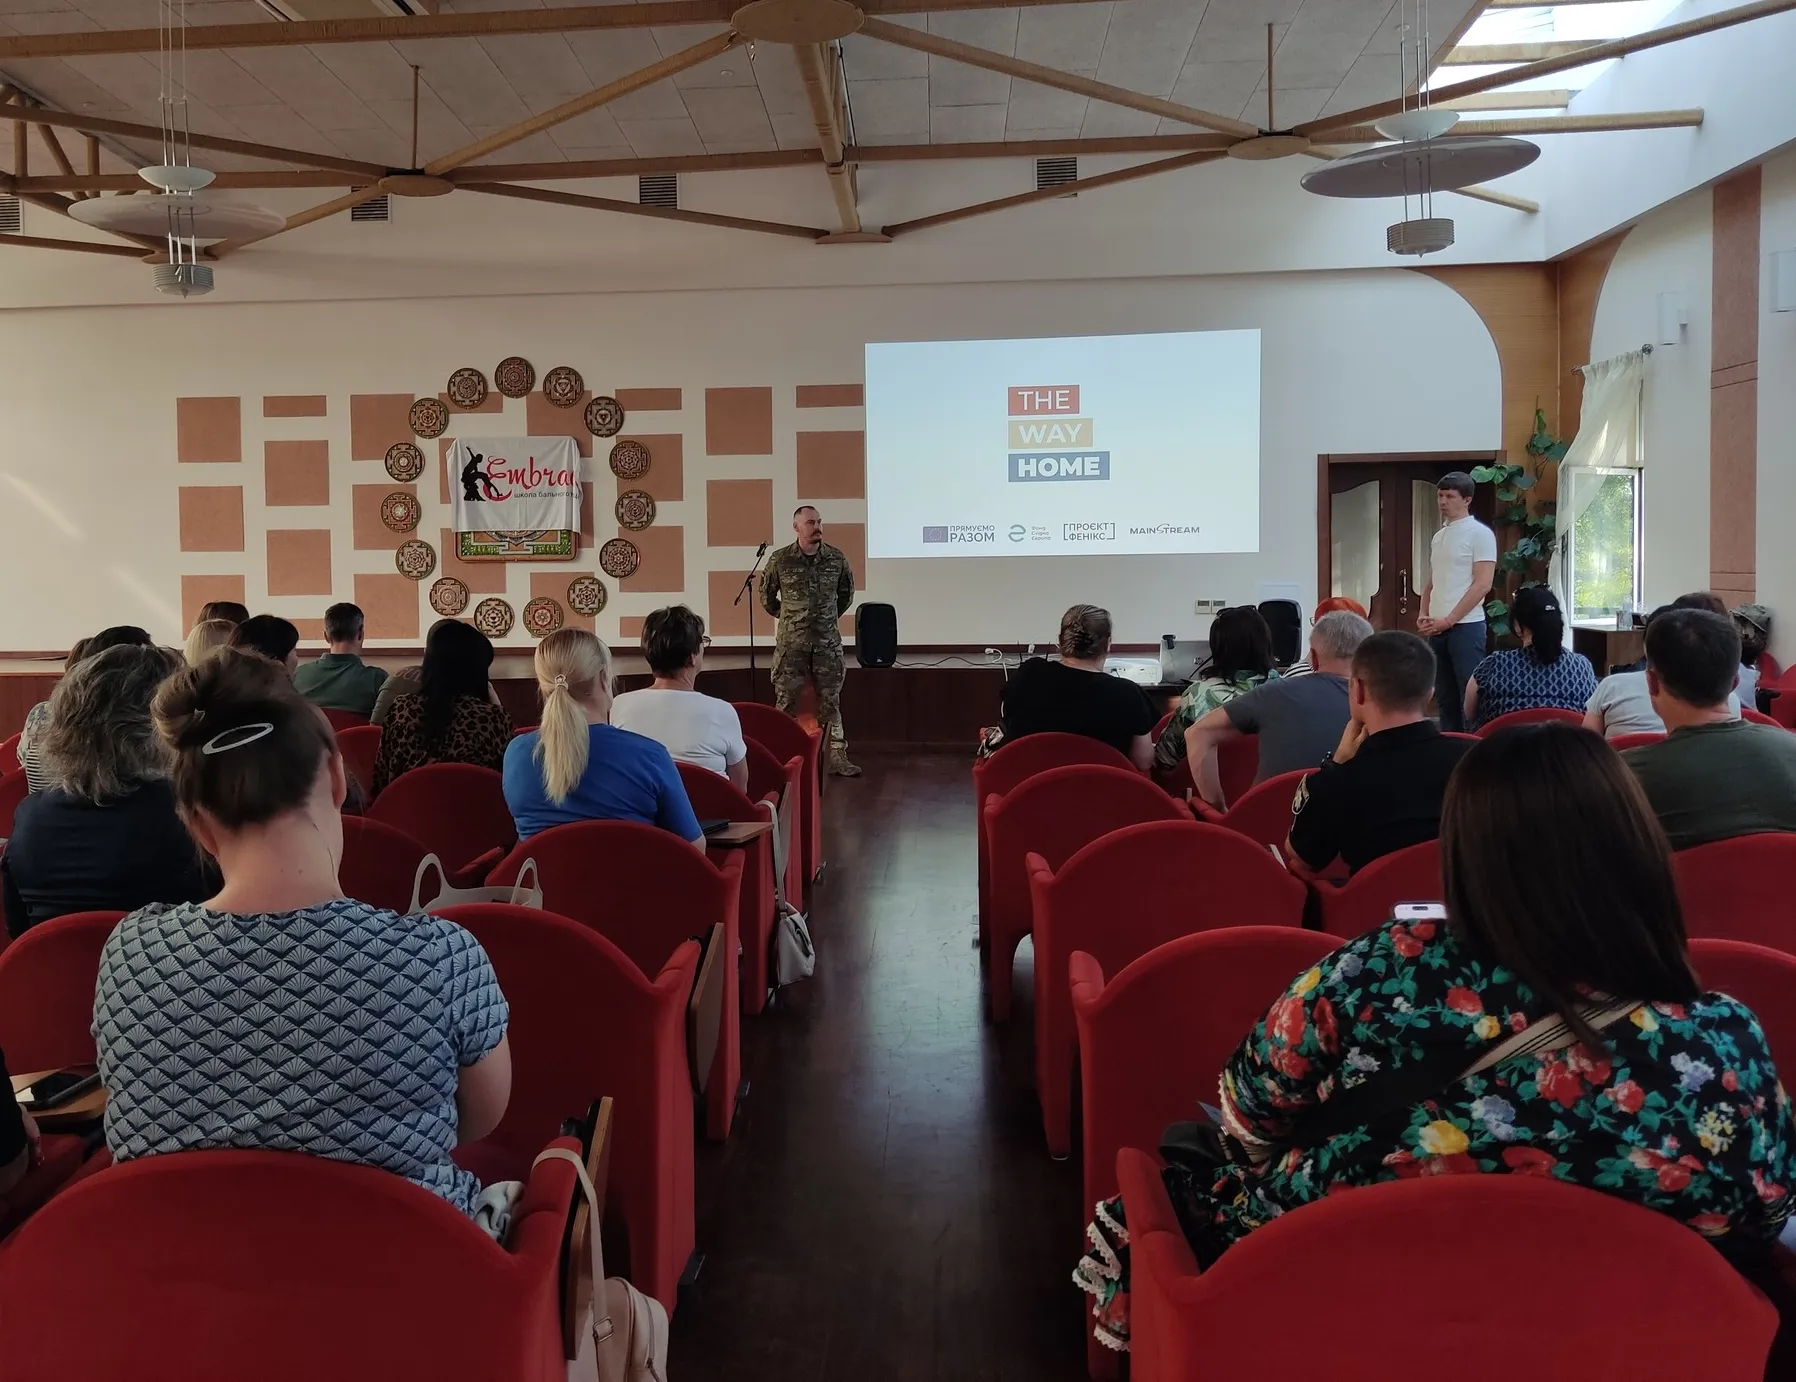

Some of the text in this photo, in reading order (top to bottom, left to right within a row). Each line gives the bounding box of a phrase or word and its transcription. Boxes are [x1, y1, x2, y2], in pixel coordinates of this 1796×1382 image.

[1017, 389, 1071, 411] THE
[1018, 423, 1083, 444] WAY
[1018, 457, 1100, 477] HOME
[1069, 522, 1109, 531] ПРОЄКТ
[950, 532, 995, 543] РАЗОМ
[1069, 532, 1106, 541] ФЕНІКС
